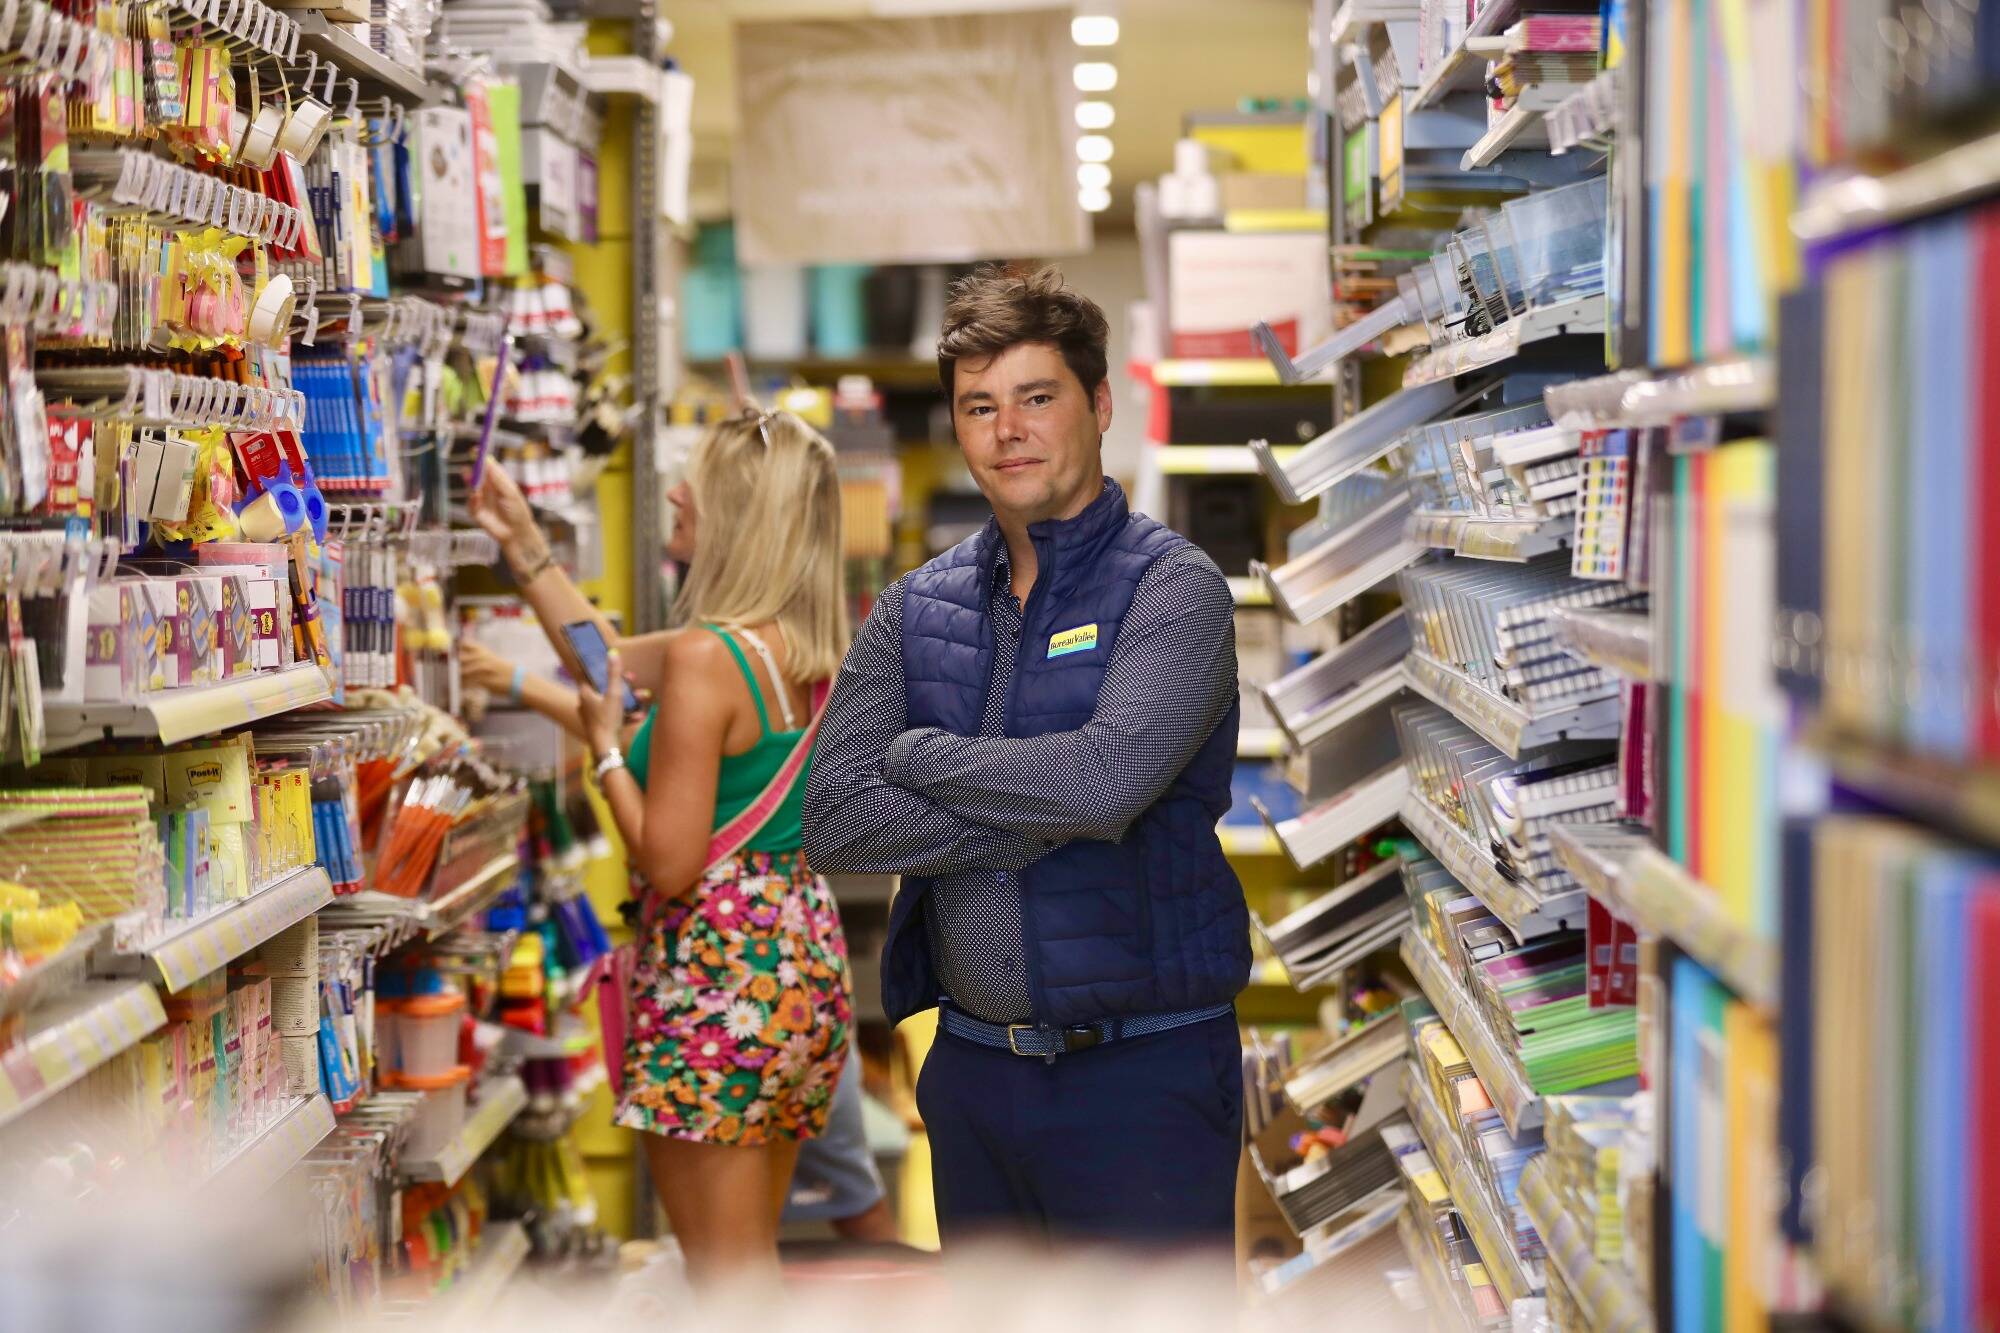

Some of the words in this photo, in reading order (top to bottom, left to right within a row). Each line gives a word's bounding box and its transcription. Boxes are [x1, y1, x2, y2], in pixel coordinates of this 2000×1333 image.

[190, 767, 219, 778] Post-it
[274, 780, 281, 791] 3M
[294, 774, 302, 786] 3M
